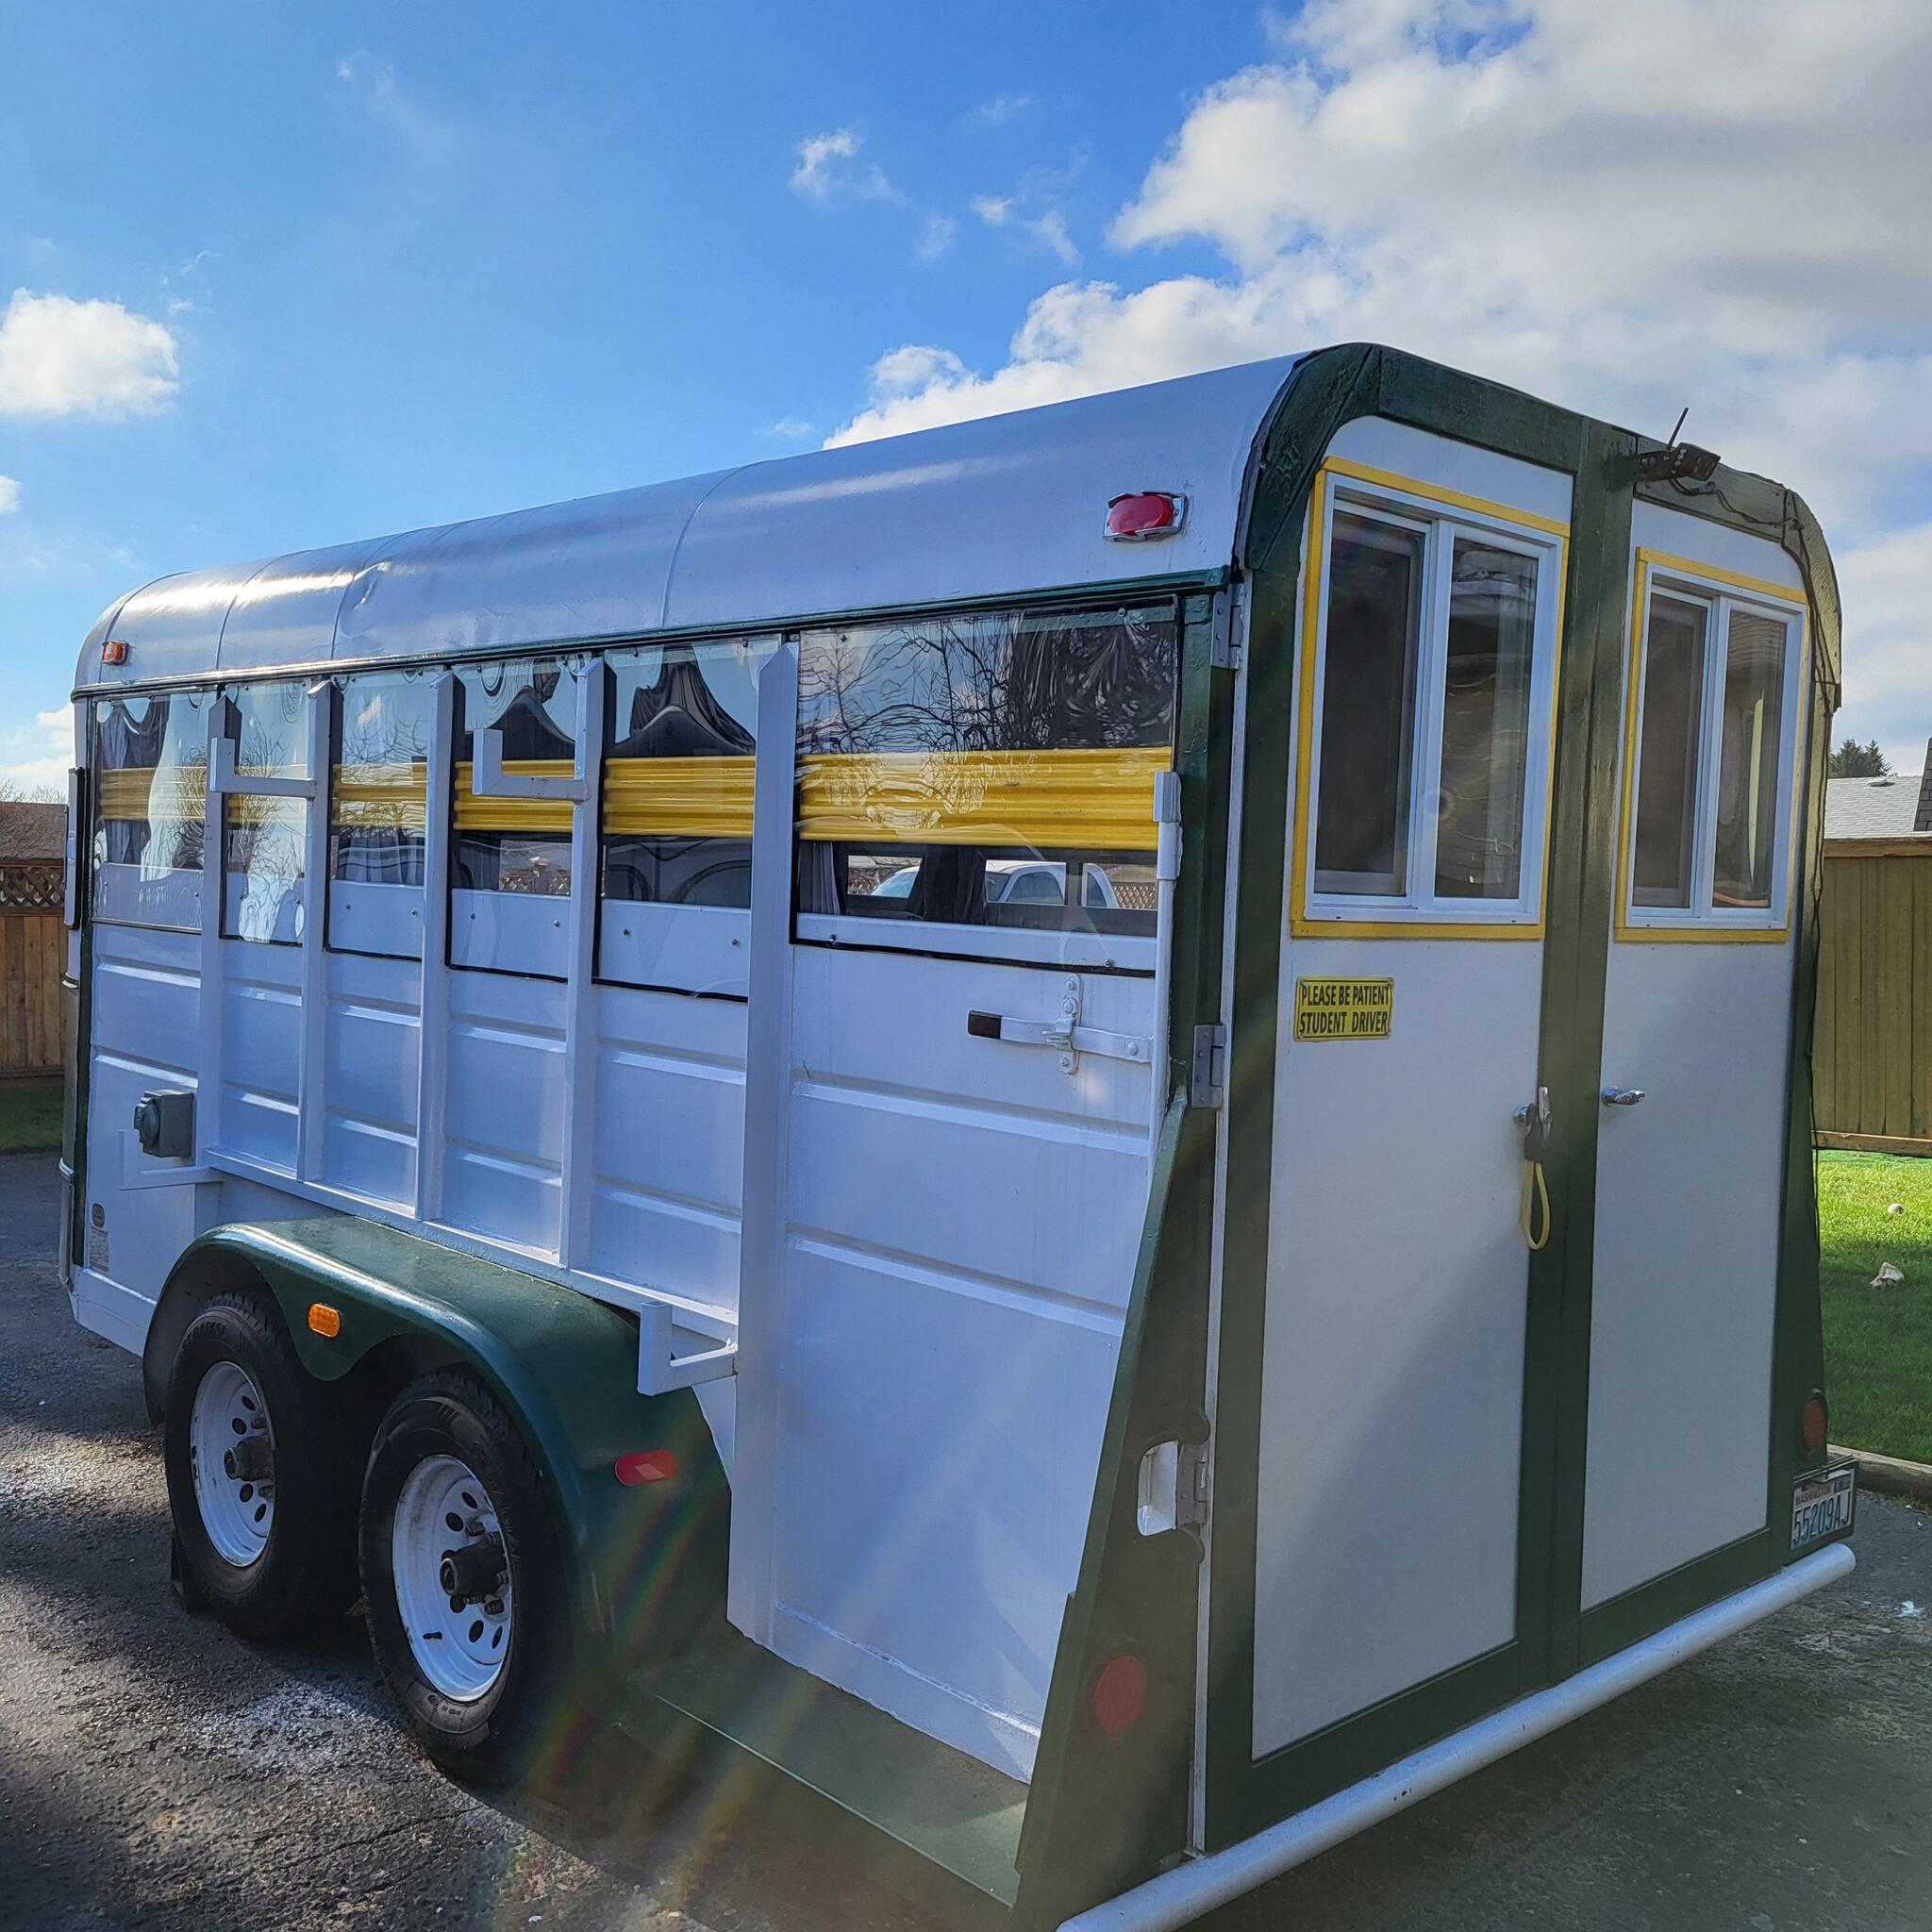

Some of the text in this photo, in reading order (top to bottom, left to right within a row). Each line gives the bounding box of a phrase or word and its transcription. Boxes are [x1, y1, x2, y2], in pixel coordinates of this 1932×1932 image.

[1301, 985, 1390, 1006] PLEASE BE PATIENT
[1299, 1011, 1388, 1034] STUDENT DRIVER
[1793, 1491, 1851, 1544] 55209AJ
